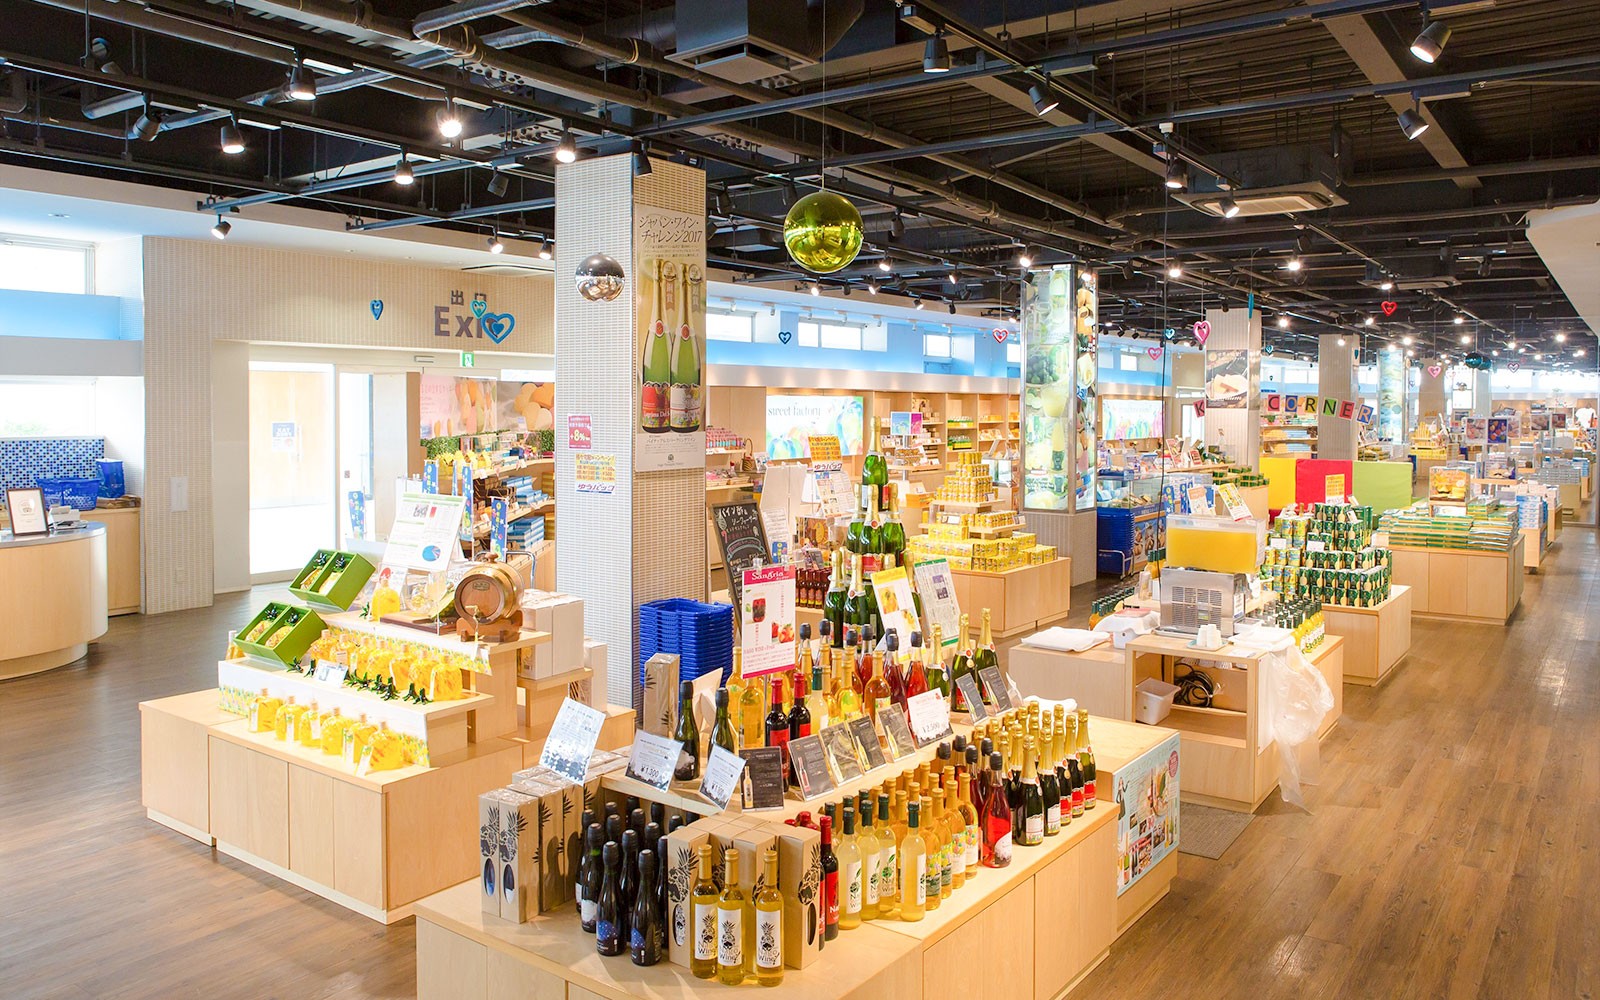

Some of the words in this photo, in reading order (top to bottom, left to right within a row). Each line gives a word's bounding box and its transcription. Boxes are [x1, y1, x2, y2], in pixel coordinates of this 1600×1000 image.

[641, 229, 703, 243] チャレンジ2017
[1267, 395, 1372, 422] CORNER
[814, 462, 842, 471] ゆうパック
[577, 483, 615, 491] ゆうパック
[751, 571, 784, 581] Sangria
